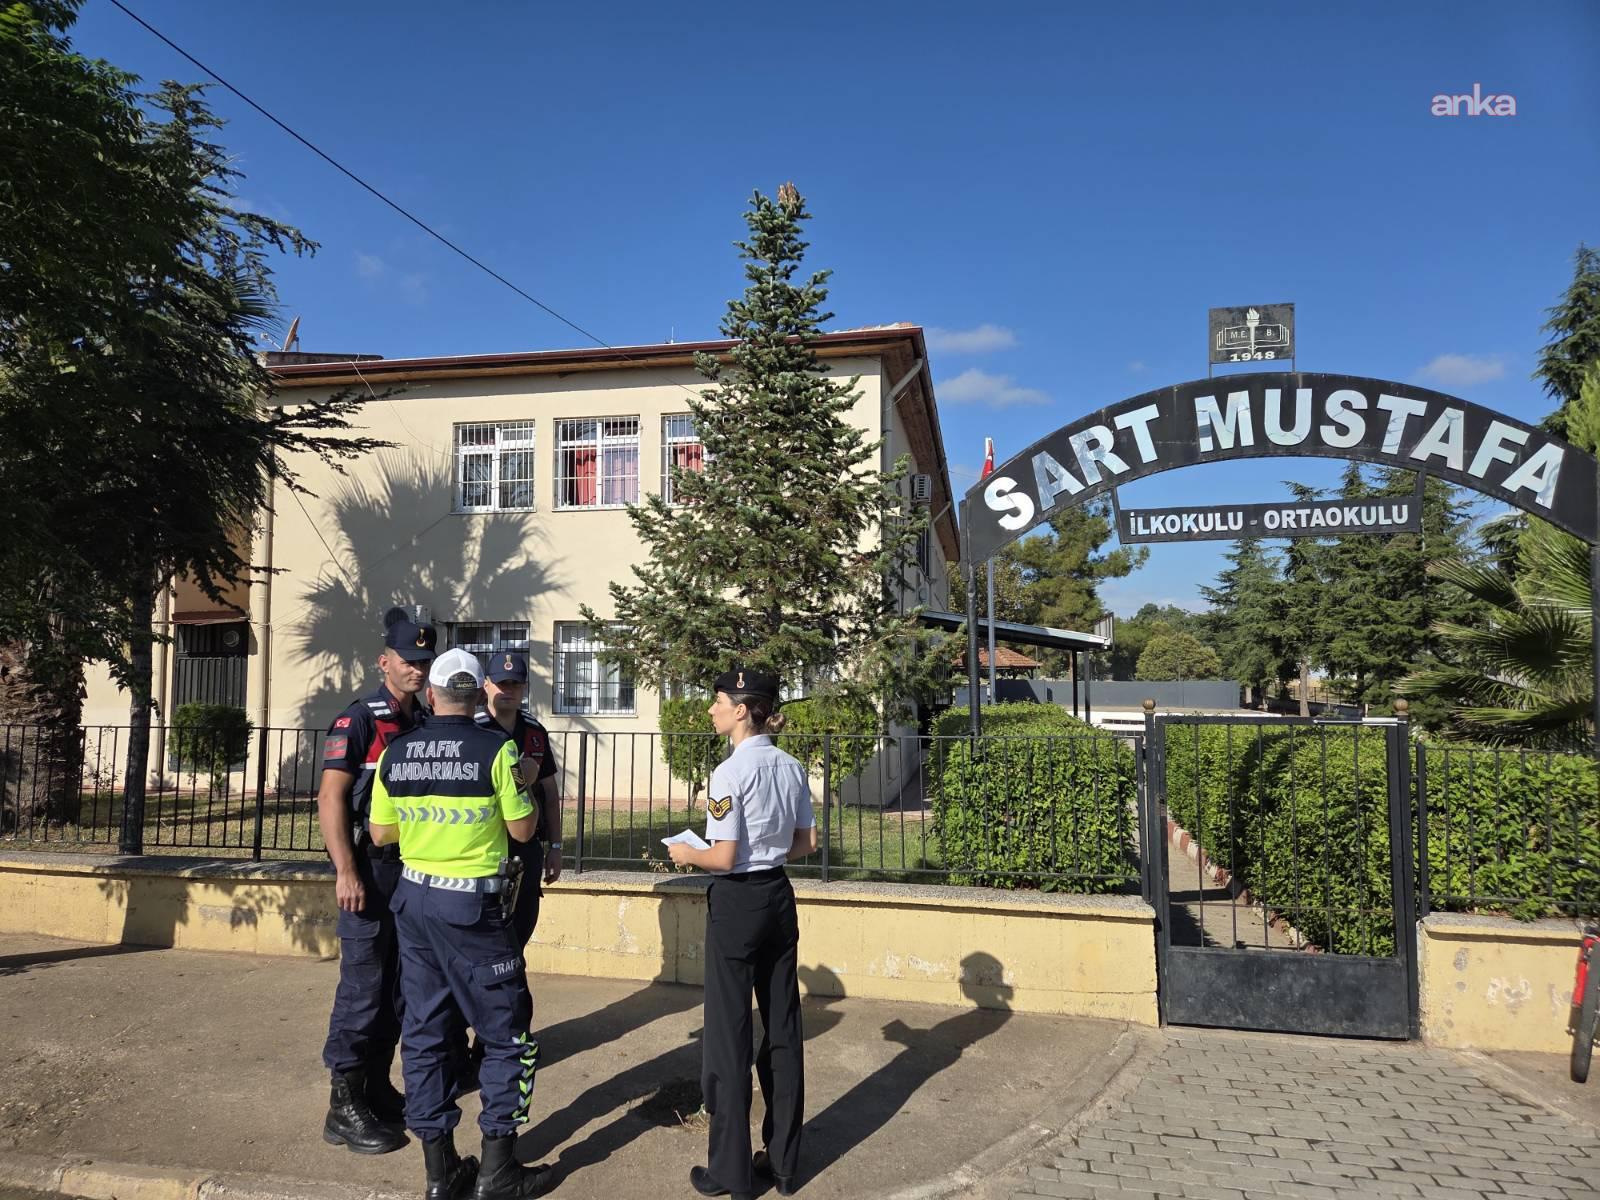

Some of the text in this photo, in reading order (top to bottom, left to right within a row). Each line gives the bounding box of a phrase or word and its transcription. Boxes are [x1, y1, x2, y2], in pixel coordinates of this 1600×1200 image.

[1230, 351, 1275, 362] 1948
[984, 389, 1565, 531] SART MUSTAFA
[1130, 512, 1243, 535] İLKOKULU
[1263, 504, 1408, 530] ORTAOKULU
[389, 761, 479, 781] JANDARMASI
